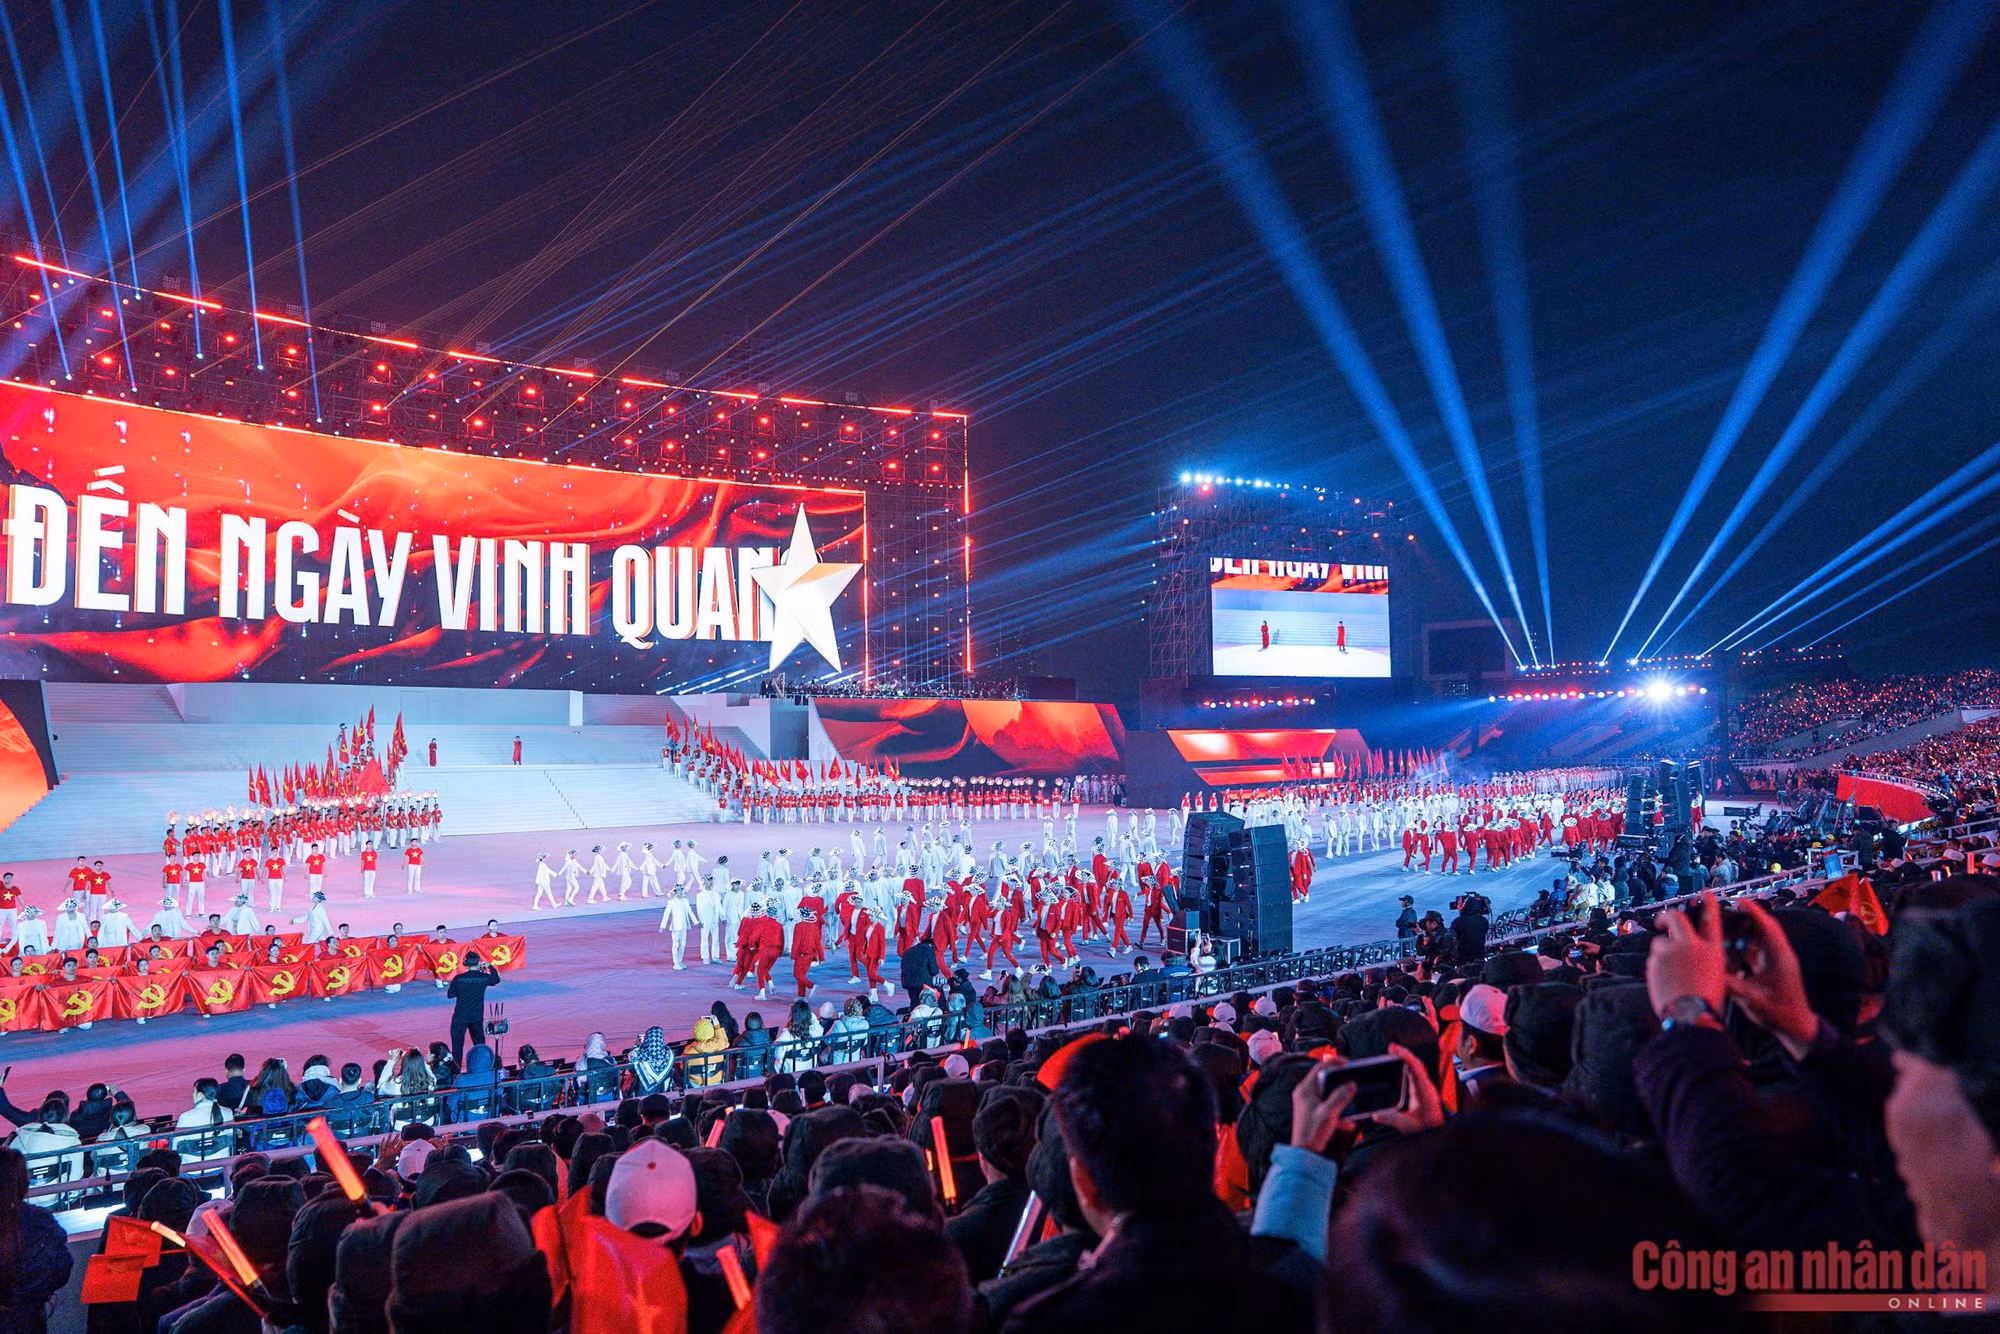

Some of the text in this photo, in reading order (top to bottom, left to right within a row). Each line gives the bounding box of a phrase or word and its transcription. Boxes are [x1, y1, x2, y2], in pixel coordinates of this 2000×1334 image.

[3, 465, 823, 650] ĐẾN NGÀY VINH QUAN
